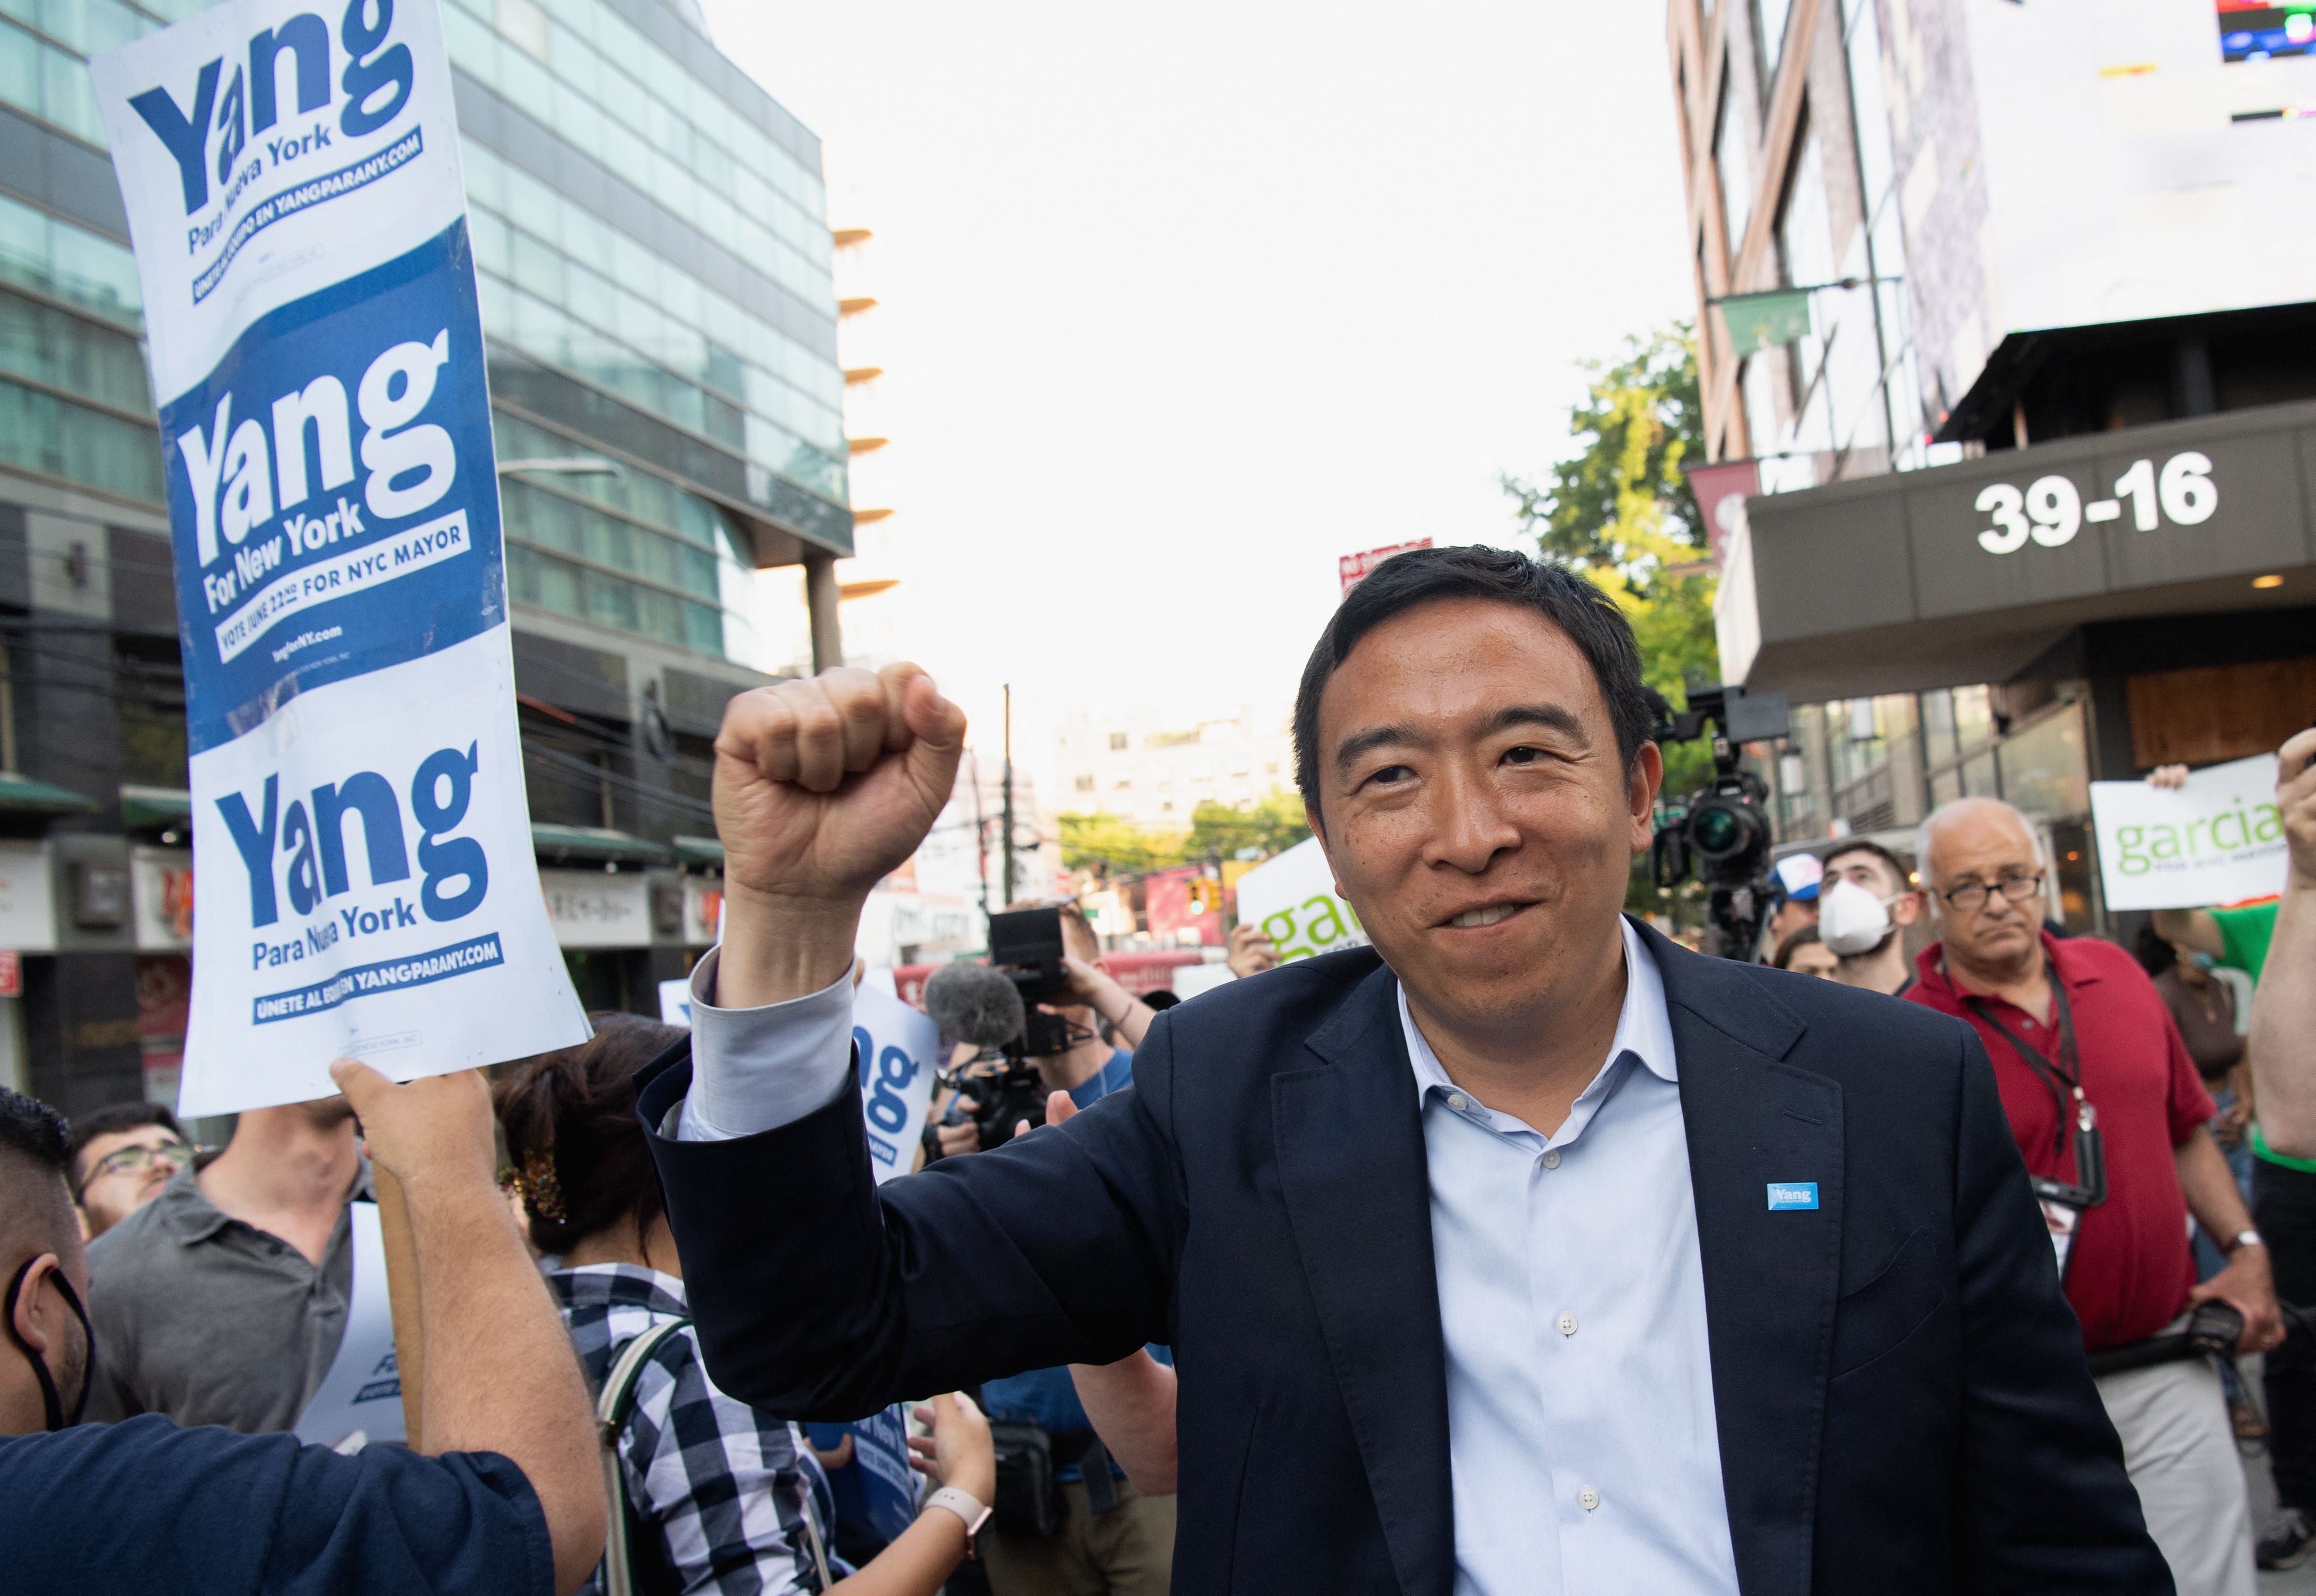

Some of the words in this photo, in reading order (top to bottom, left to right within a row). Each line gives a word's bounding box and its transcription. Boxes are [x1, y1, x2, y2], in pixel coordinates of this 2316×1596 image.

[126, 0, 414, 216] Yang
[188, 213, 222, 255] Para
[266, 124, 332, 167] York
[275, 133, 420, 214] YANGPARANY.COM
[177, 327, 456, 568] Yang
[203, 571, 238, 614] For
[234, 536, 282, 591] New
[283, 497, 365, 556] York
[1974, 451, 2218, 555] 39-16
[221, 621, 247, 650] VOTE
[247, 602, 268, 632] JUNE
[303, 569, 340, 597] FOR
[347, 553, 388, 582] NYC
[394, 524, 462, 566] MAYOR
[214, 738, 488, 929] Yang
[2116, 796, 2286, 875] garcia
[253, 939, 304, 970] Para
[340, 897, 417, 937] York
[305, 990, 323, 1010] AL
[355, 941, 499, 990] YANGPARANY.COM
[1777, 1188, 1812, 1203] Yang
